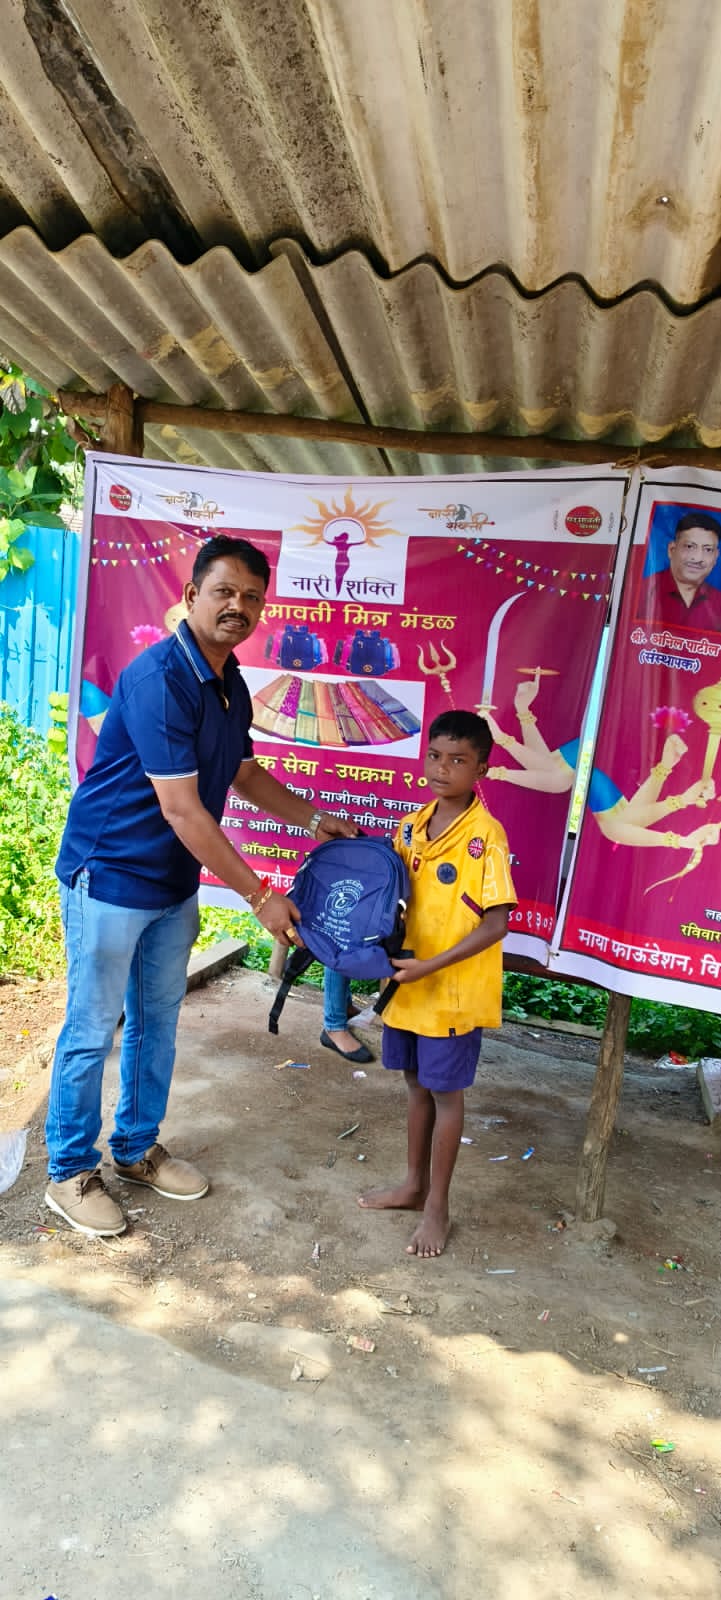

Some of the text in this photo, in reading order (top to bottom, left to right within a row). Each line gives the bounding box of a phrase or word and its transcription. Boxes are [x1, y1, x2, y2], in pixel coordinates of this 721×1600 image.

[289, 575, 399, 602] नारी शक्ति
[342, 604, 393, 627] मित्र
[400, 606, 457, 630] मंडळ
[650, 630, 684, 650] अनिल
[684, 637, 721, 656] पाटील
[638, 648, 701, 673] (संस्थापक)
[282, 751, 320, 777] सेवा
[403, 771, 428, 790] २०
[320, 789, 379, 808] माजीवली
[247, 818, 283, 834] आणि
[240, 841, 300, 860] ऑक्टोबर
[578, 928, 610, 952] माया
[701, 953, 721, 978] वि
